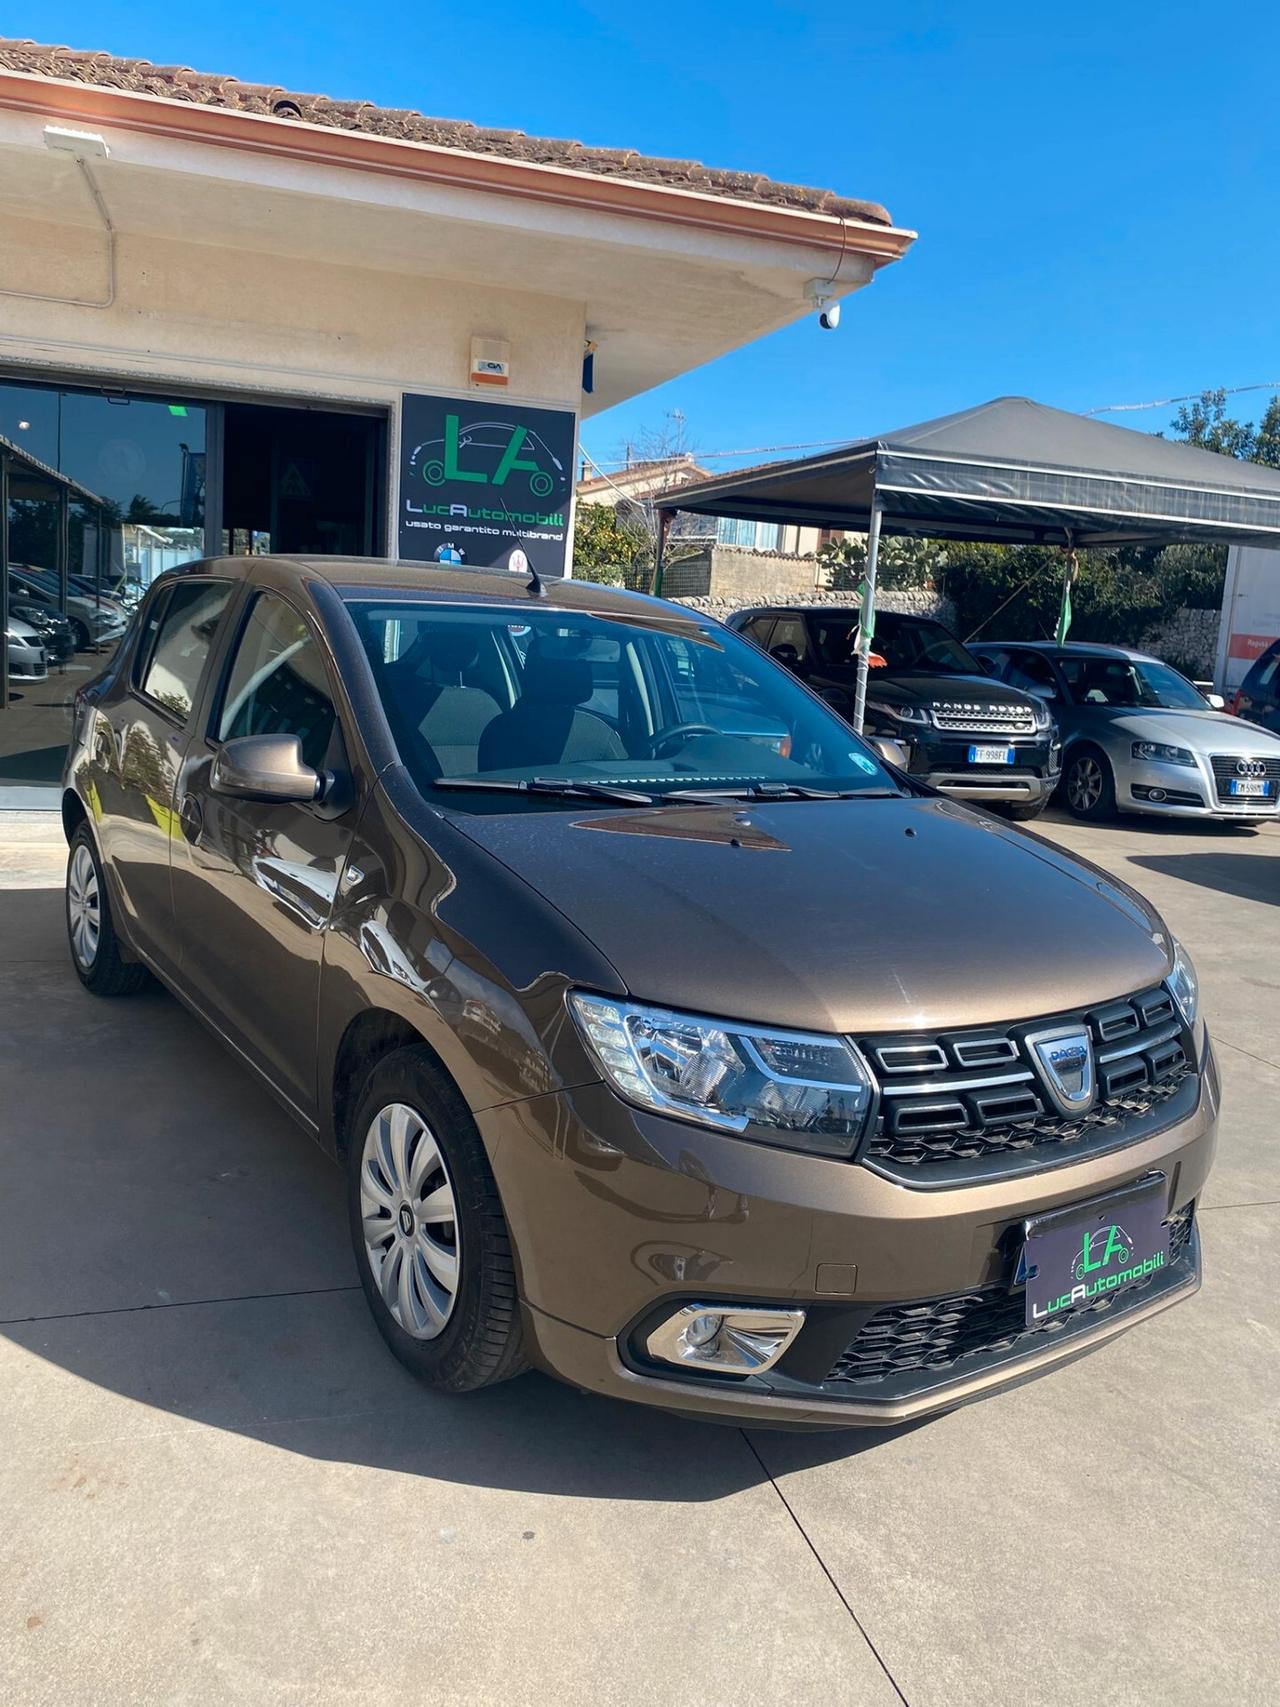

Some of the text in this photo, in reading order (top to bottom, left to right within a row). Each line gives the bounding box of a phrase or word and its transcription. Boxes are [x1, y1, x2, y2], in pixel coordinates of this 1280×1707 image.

[406, 499, 564, 527] LucAutomobili
[405, 520, 563, 541] usato garantito multibrand
[932, 702, 1032, 713] RANGE ROVER
[1050, 1045, 1086, 1060] DACIA
[1032, 1251, 1165, 1319] LucAutomobili
